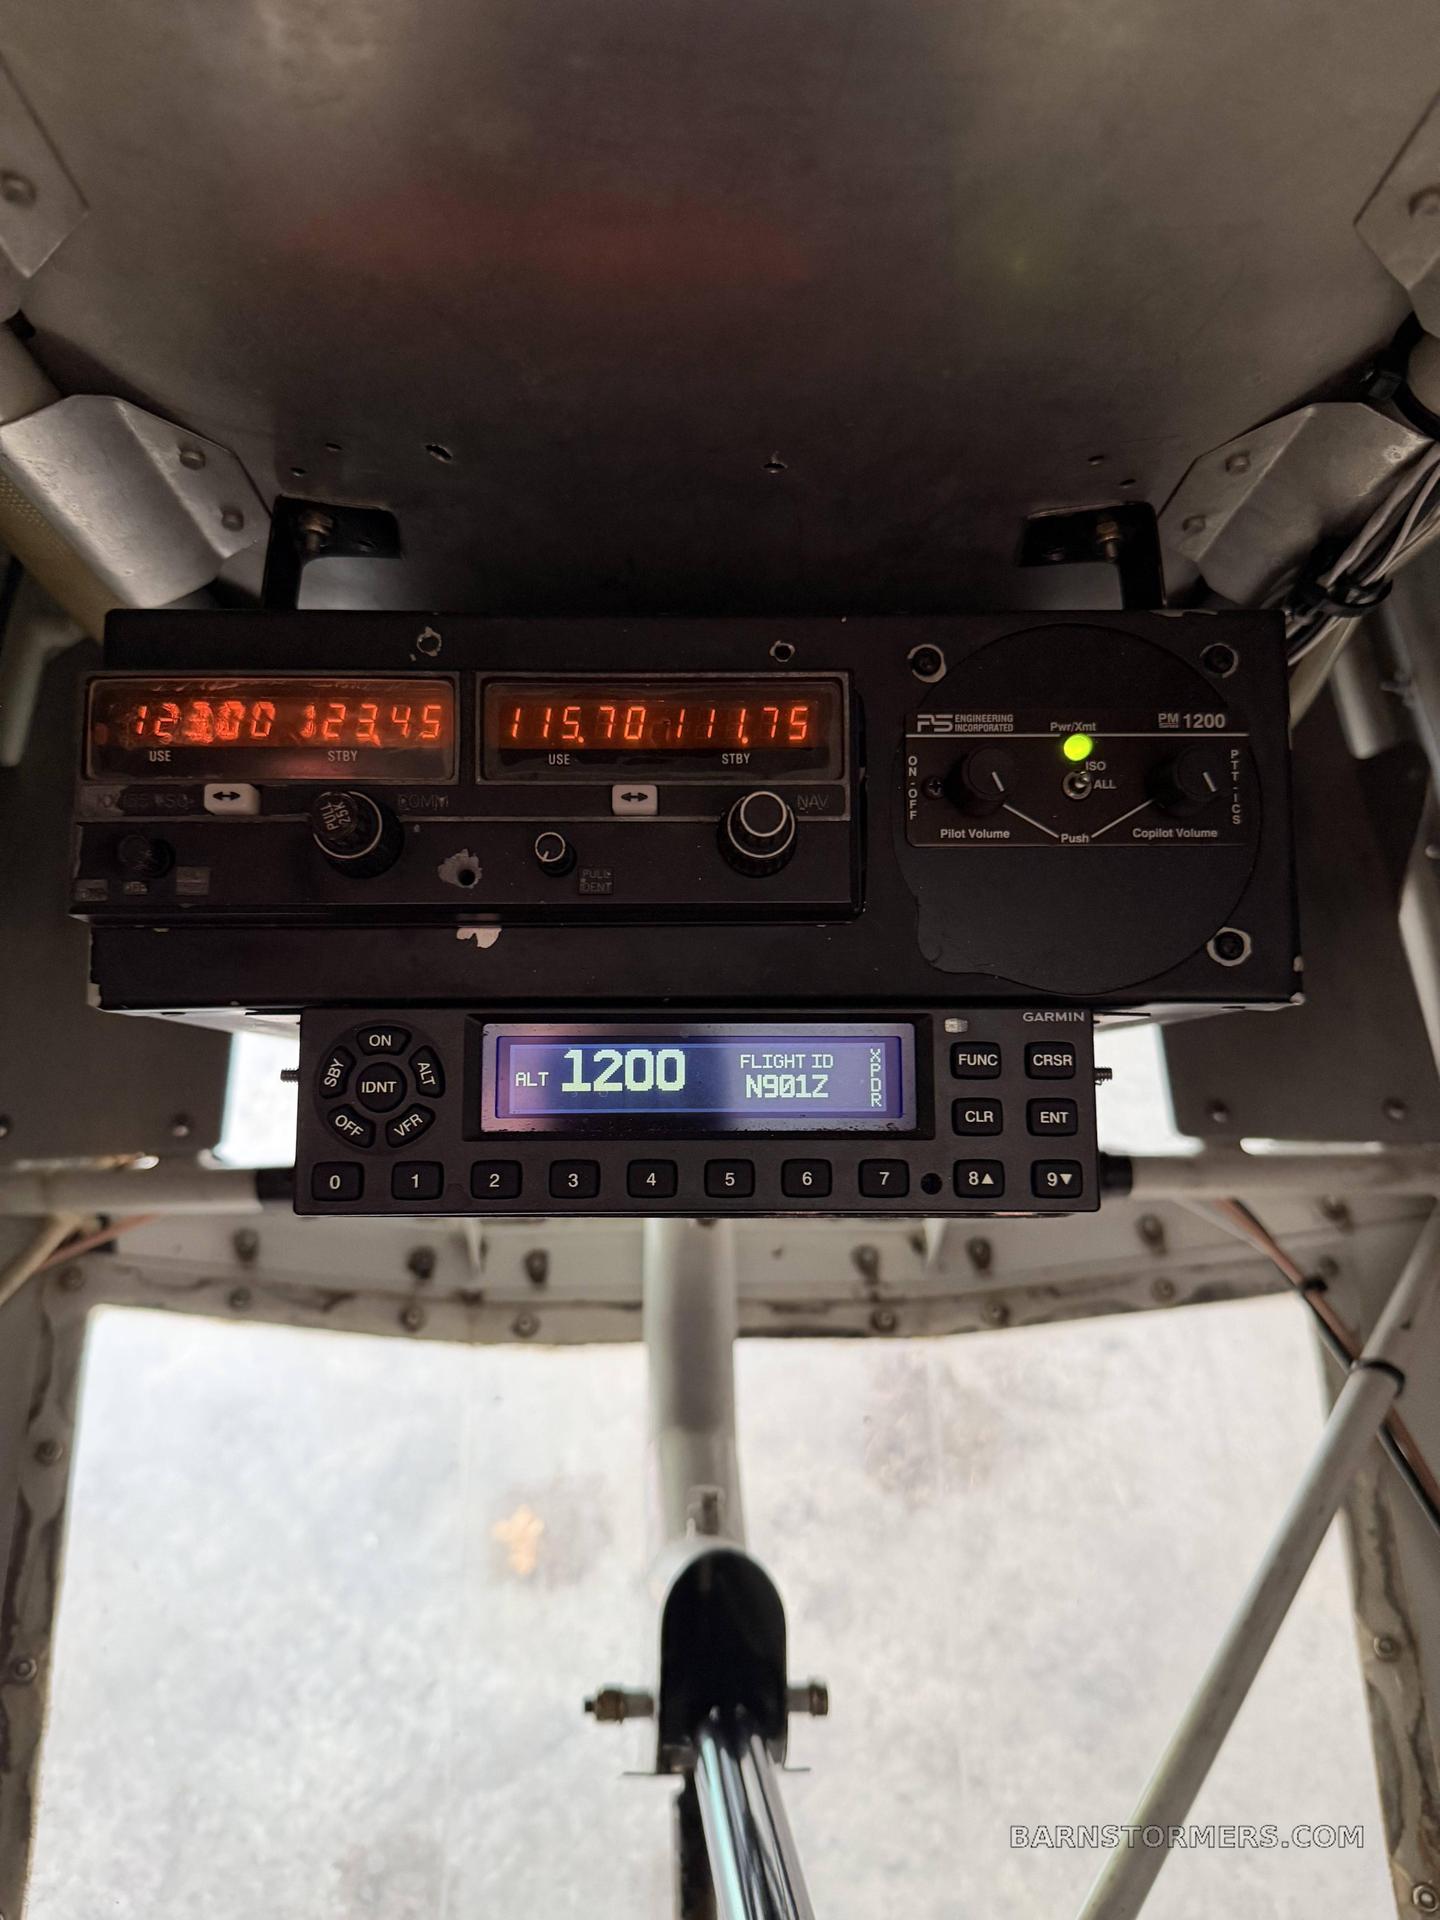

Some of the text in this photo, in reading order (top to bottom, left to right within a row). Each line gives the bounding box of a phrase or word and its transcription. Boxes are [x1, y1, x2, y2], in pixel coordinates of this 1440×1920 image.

[511, 706, 809, 744] 115.70 111.75
[954, 714, 1014, 723] ENGINEERING
[1158, 713, 1226, 728] PM 1200
[954, 723, 1014, 732] INCORPORATED
[1050, 722, 1096, 732] Pwr/Xmt
[149, 750, 172, 762] USE
[327, 750, 358, 762] STBY
[548, 753, 571, 765] USE
[721, 753, 751, 765] STBY
[1085, 761, 1106, 771] ISO
[1093, 779, 1117, 790] ALL
[797, 794, 830, 810] NAV
[319, 801, 341, 831] PULL
[332, 801, 352, 825] 25K
[940, 828, 1010, 839] Pilot Volume
[1060, 833, 1090, 844] Push
[1132, 828, 1218, 841] Copilot Volume
[1022, 1011, 1085, 1023] GARMIN
[368, 1034, 392, 1048] ON
[740, 1054, 834, 1069] FLIGHT ID
[958, 1053, 998, 1066] FUNC
[1032, 1053, 1073, 1067] CRSR
[323, 1058, 344, 1088] SBY
[416, 1061, 436, 1087] ALT
[561, 1048, 686, 1092] 1200
[515, 1072, 549, 1087] ALT
[869, 1048, 882, 1107] XPDR
[360, 1080, 397, 1094] IDNT
[745, 1074, 829, 1098] N901Z
[964, 1110, 994, 1124] CLR
[1039, 1111, 1069, 1124] ENT
[334, 1114, 364, 1139] OFF
[393, 1113, 423, 1138] VFR
[329, 1174, 341, 1190] 0
[411, 1174, 419, 1188] 1
[488, 1173, 500, 1188] 2
[567, 1173, 579, 1188] 3
[646, 1173, 657, 1187] 4
[724, 1172, 735, 1186] 5
[801, 1171, 813, 1185] 6
[879, 1171, 890, 1185] 7
[968, 1171, 979, 1185] 8
[1047, 1172, 1057, 1186] 9
